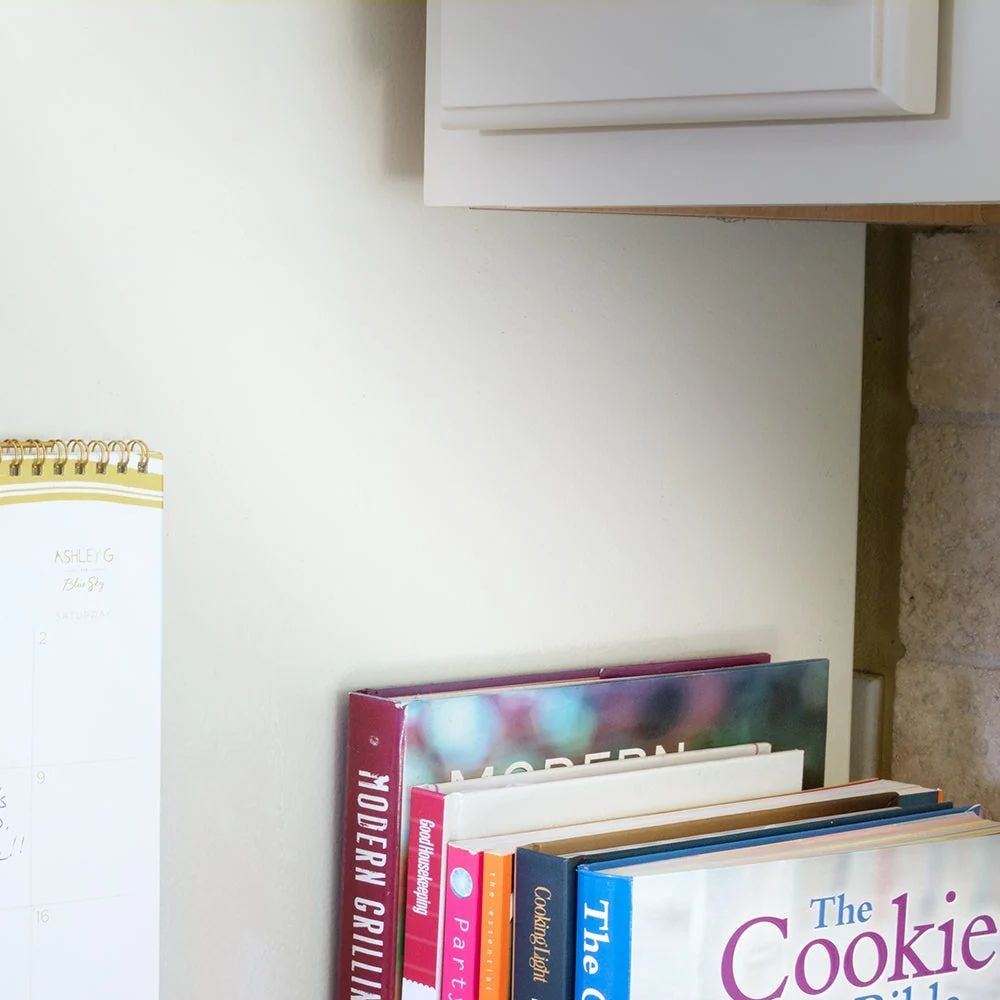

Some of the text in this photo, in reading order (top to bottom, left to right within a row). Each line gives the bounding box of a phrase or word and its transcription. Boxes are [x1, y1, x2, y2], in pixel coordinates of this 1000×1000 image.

[53, 546, 115, 564] ASHLEY G
[54, 607, 113, 620] SATURDAY
[38, 631, 48, 646] 2
[36, 770, 46, 785] 9
[355, 770, 389, 886] MODERN
[488, 872, 496, 898] the
[36, 908, 50, 924] 16
[810, 893, 873, 929] The
[582, 899, 611, 976] The
